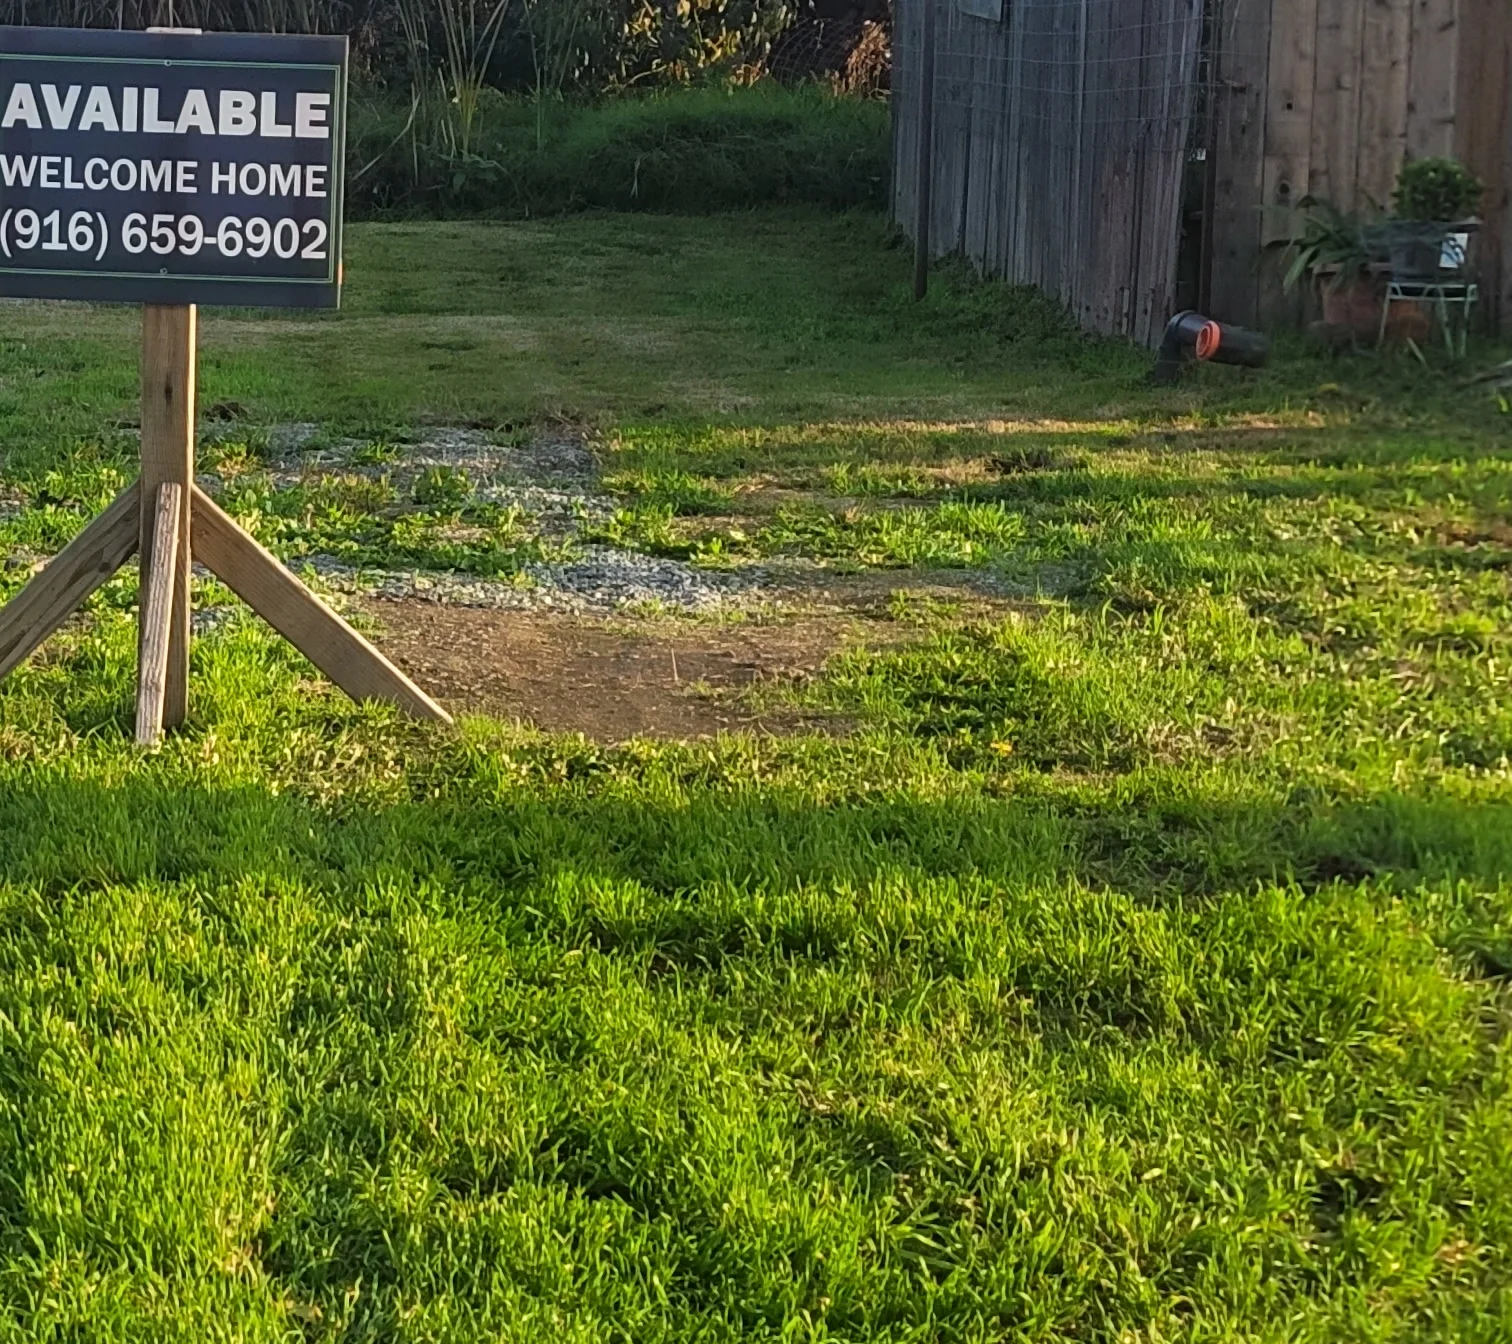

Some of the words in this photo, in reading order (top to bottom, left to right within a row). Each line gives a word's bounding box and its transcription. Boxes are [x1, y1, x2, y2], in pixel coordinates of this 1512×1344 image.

[1, 83, 331, 138] AVAILABLE
[0, 154, 198, 193] WELCOME
[211, 162, 328, 197] HOME
[0, 208, 109, 261] (916)
[121, 213, 327, 259] 659-6902
